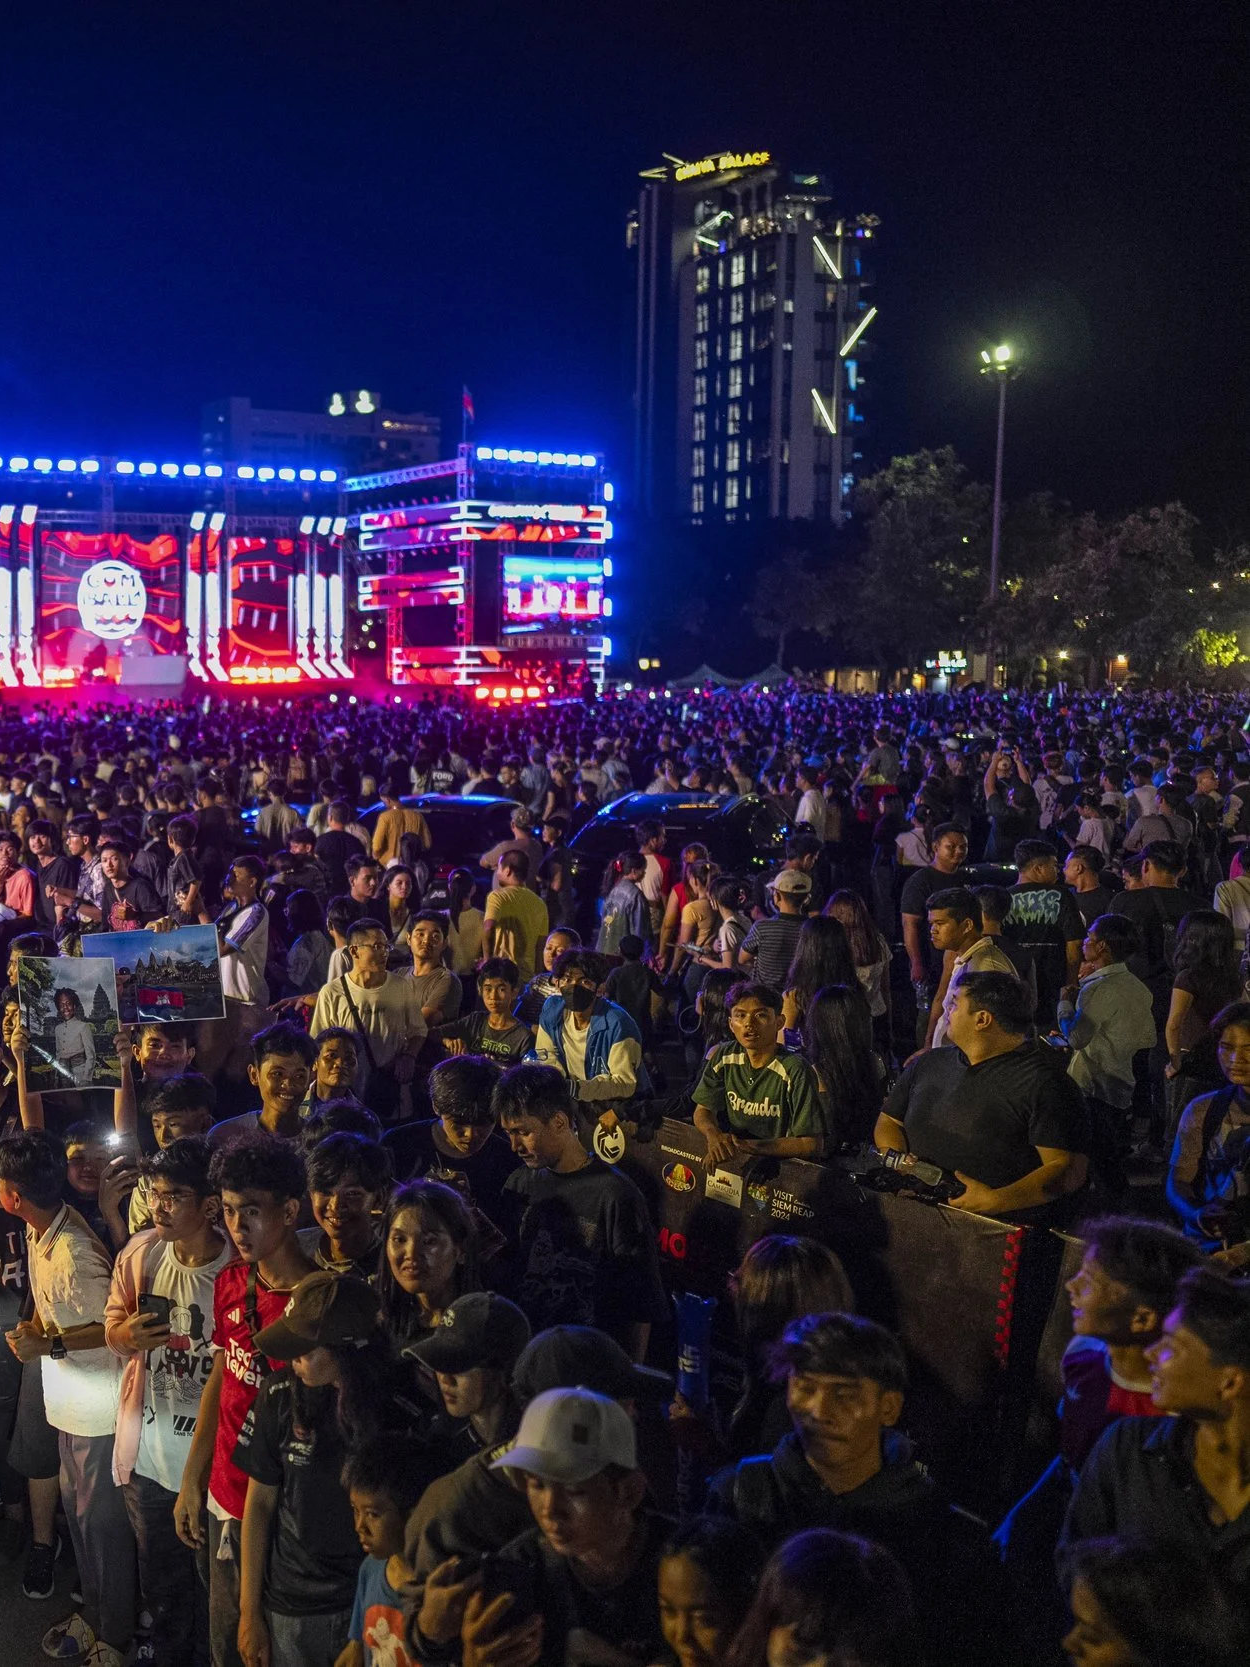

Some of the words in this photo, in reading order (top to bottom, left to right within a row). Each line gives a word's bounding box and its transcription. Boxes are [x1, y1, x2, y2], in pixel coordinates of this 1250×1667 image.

[772, 1188, 794, 1202] VISIT
[771, 1199, 792, 1212] SIEM
[792, 1205, 815, 1218] REAP
[771, 1208, 791, 1220] 2024
